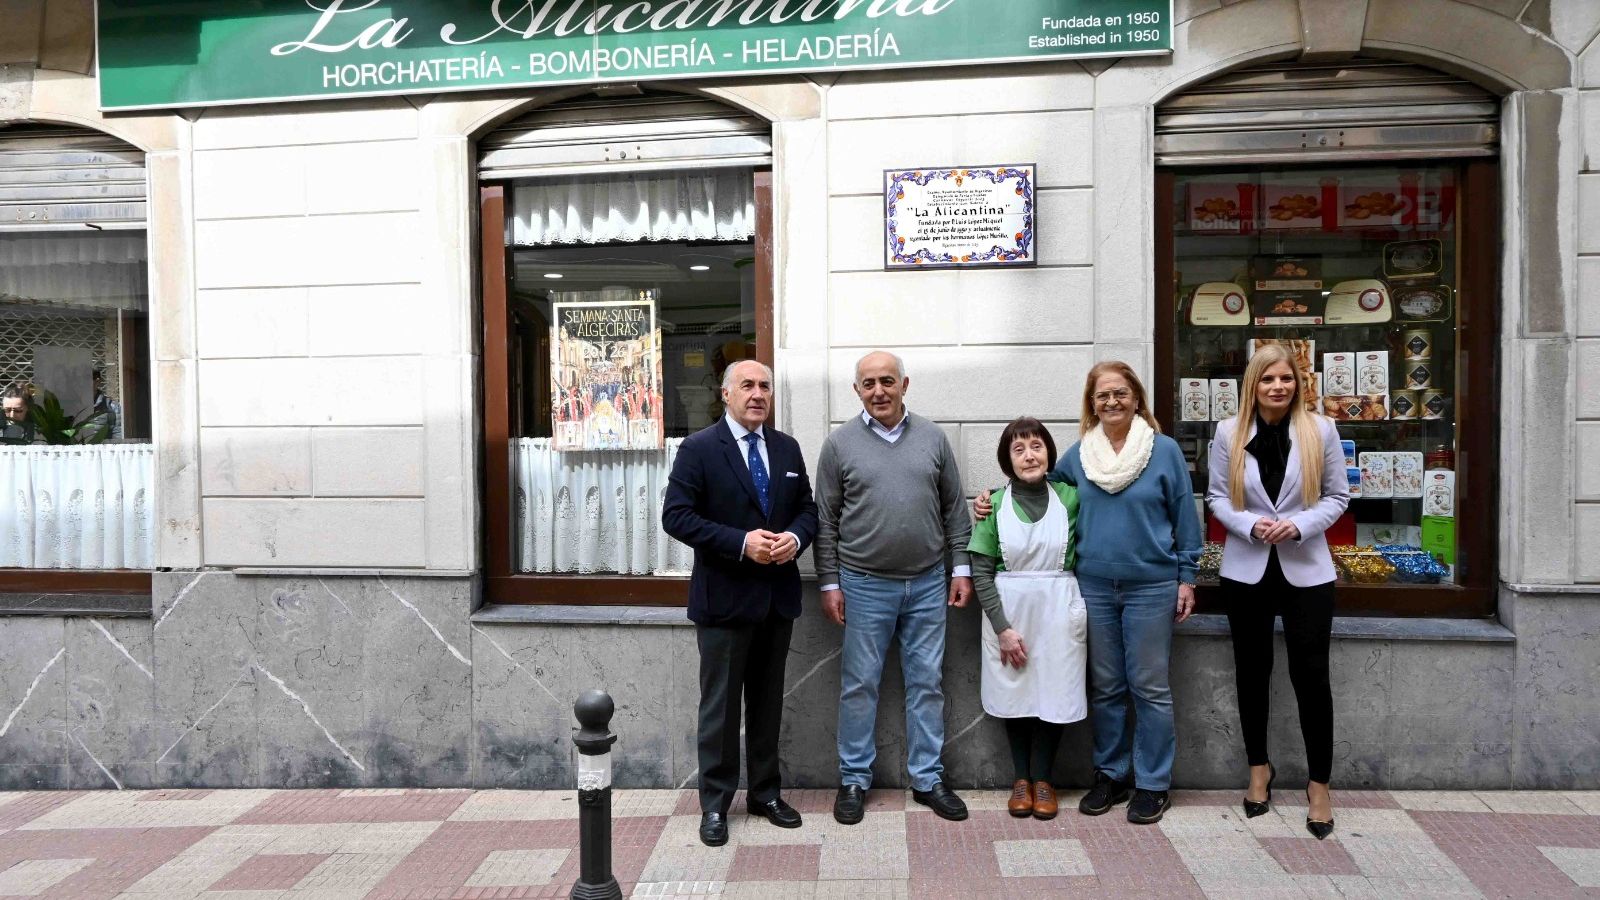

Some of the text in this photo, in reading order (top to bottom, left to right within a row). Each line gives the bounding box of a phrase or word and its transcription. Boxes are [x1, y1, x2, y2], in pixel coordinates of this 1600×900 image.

[270, 0, 414, 56] La
[1042, 12, 1160, 30] Fundada en 1950
[1028, 29, 1160, 48] Established in 1950
[322, 51, 505, 88] HORCHATERÍA
[529, 38, 716, 75] BOMBONERÍA
[741, 28, 901, 64] HELADERÍA
[577, 321, 639, 337] ALGECIRAS
